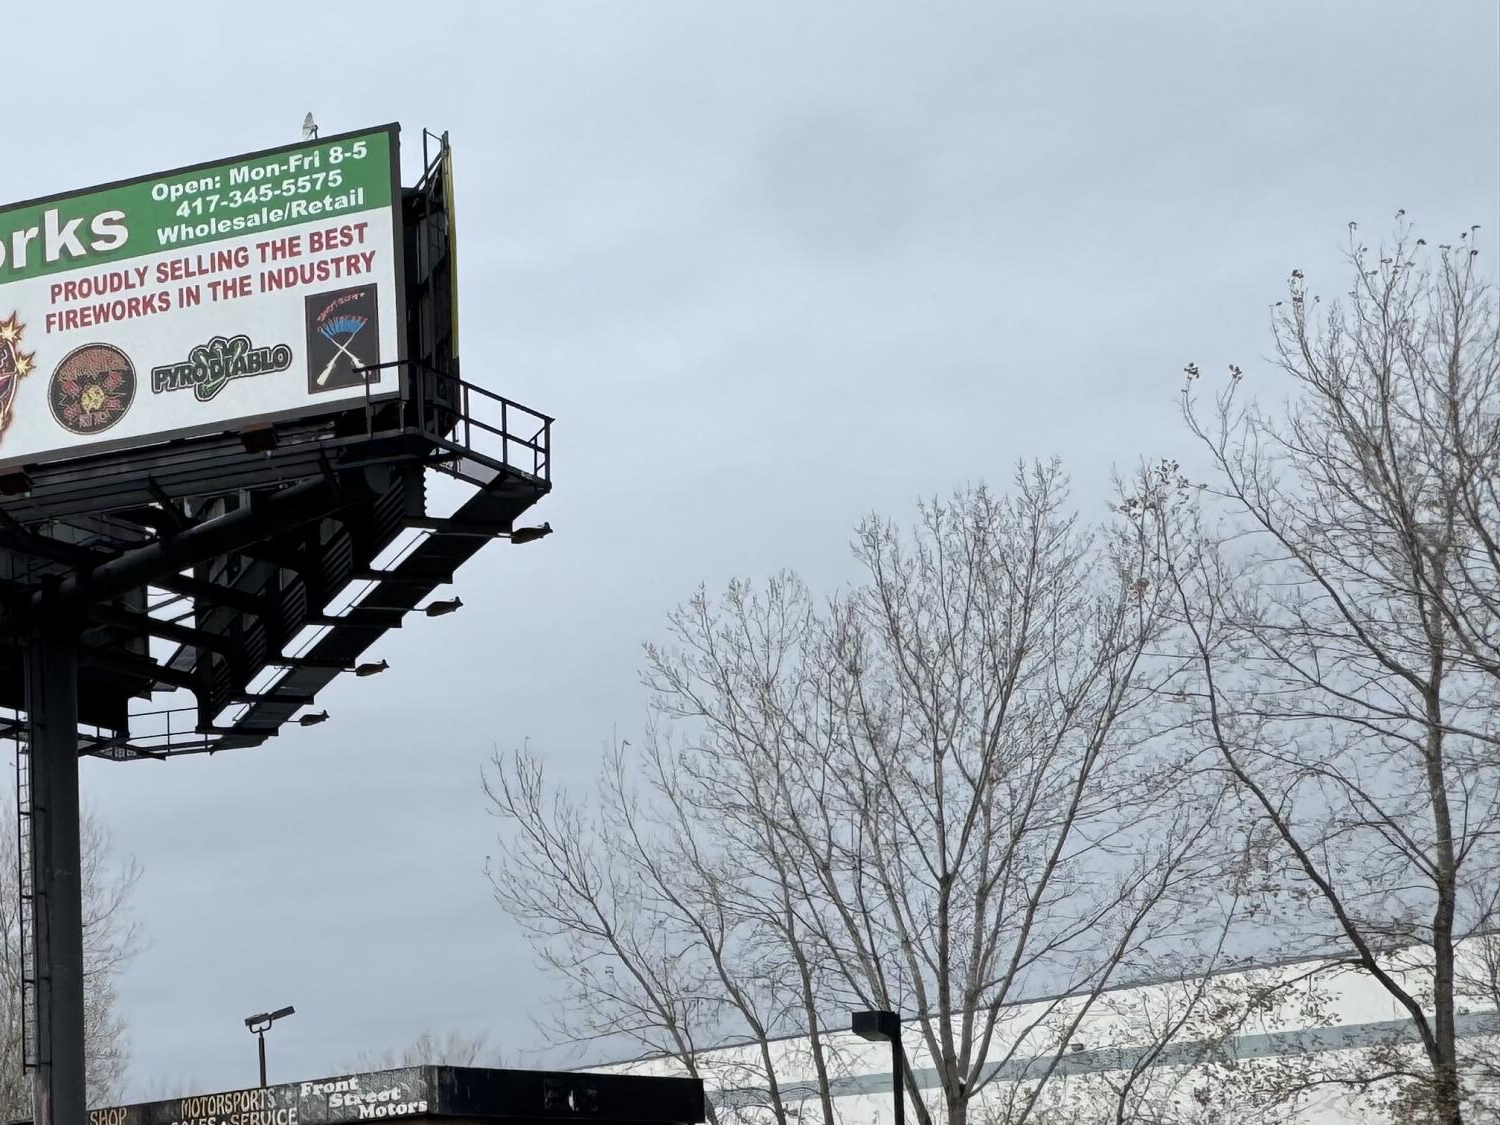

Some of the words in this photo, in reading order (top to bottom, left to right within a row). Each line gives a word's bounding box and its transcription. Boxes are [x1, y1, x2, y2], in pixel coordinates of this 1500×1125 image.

[151, 174, 222, 202] Open:
[229, 151, 319, 187] Mon-Fri
[329, 141, 367, 164] 8-5
[176, 169, 342, 218] 417-345-5575
[157, 188, 364, 245] Wholesale/Retail
[50, 266, 149, 304] PROUDLY
[156, 247, 249, 282] SELLING
[256, 237, 301, 265] THE
[309, 223, 368, 254] BEST
[45, 290, 171, 334] FIREWORKS
[178, 282, 201, 307] IN
[207, 268, 252, 302] THE
[260, 250, 377, 293] INDUSTRY
[181, 1087, 276, 1120] MOTORSPORTS
[300, 1076, 360, 1098] Front
[328, 1086, 403, 1108] Street
[359, 1100, 428, 1120] Motors
